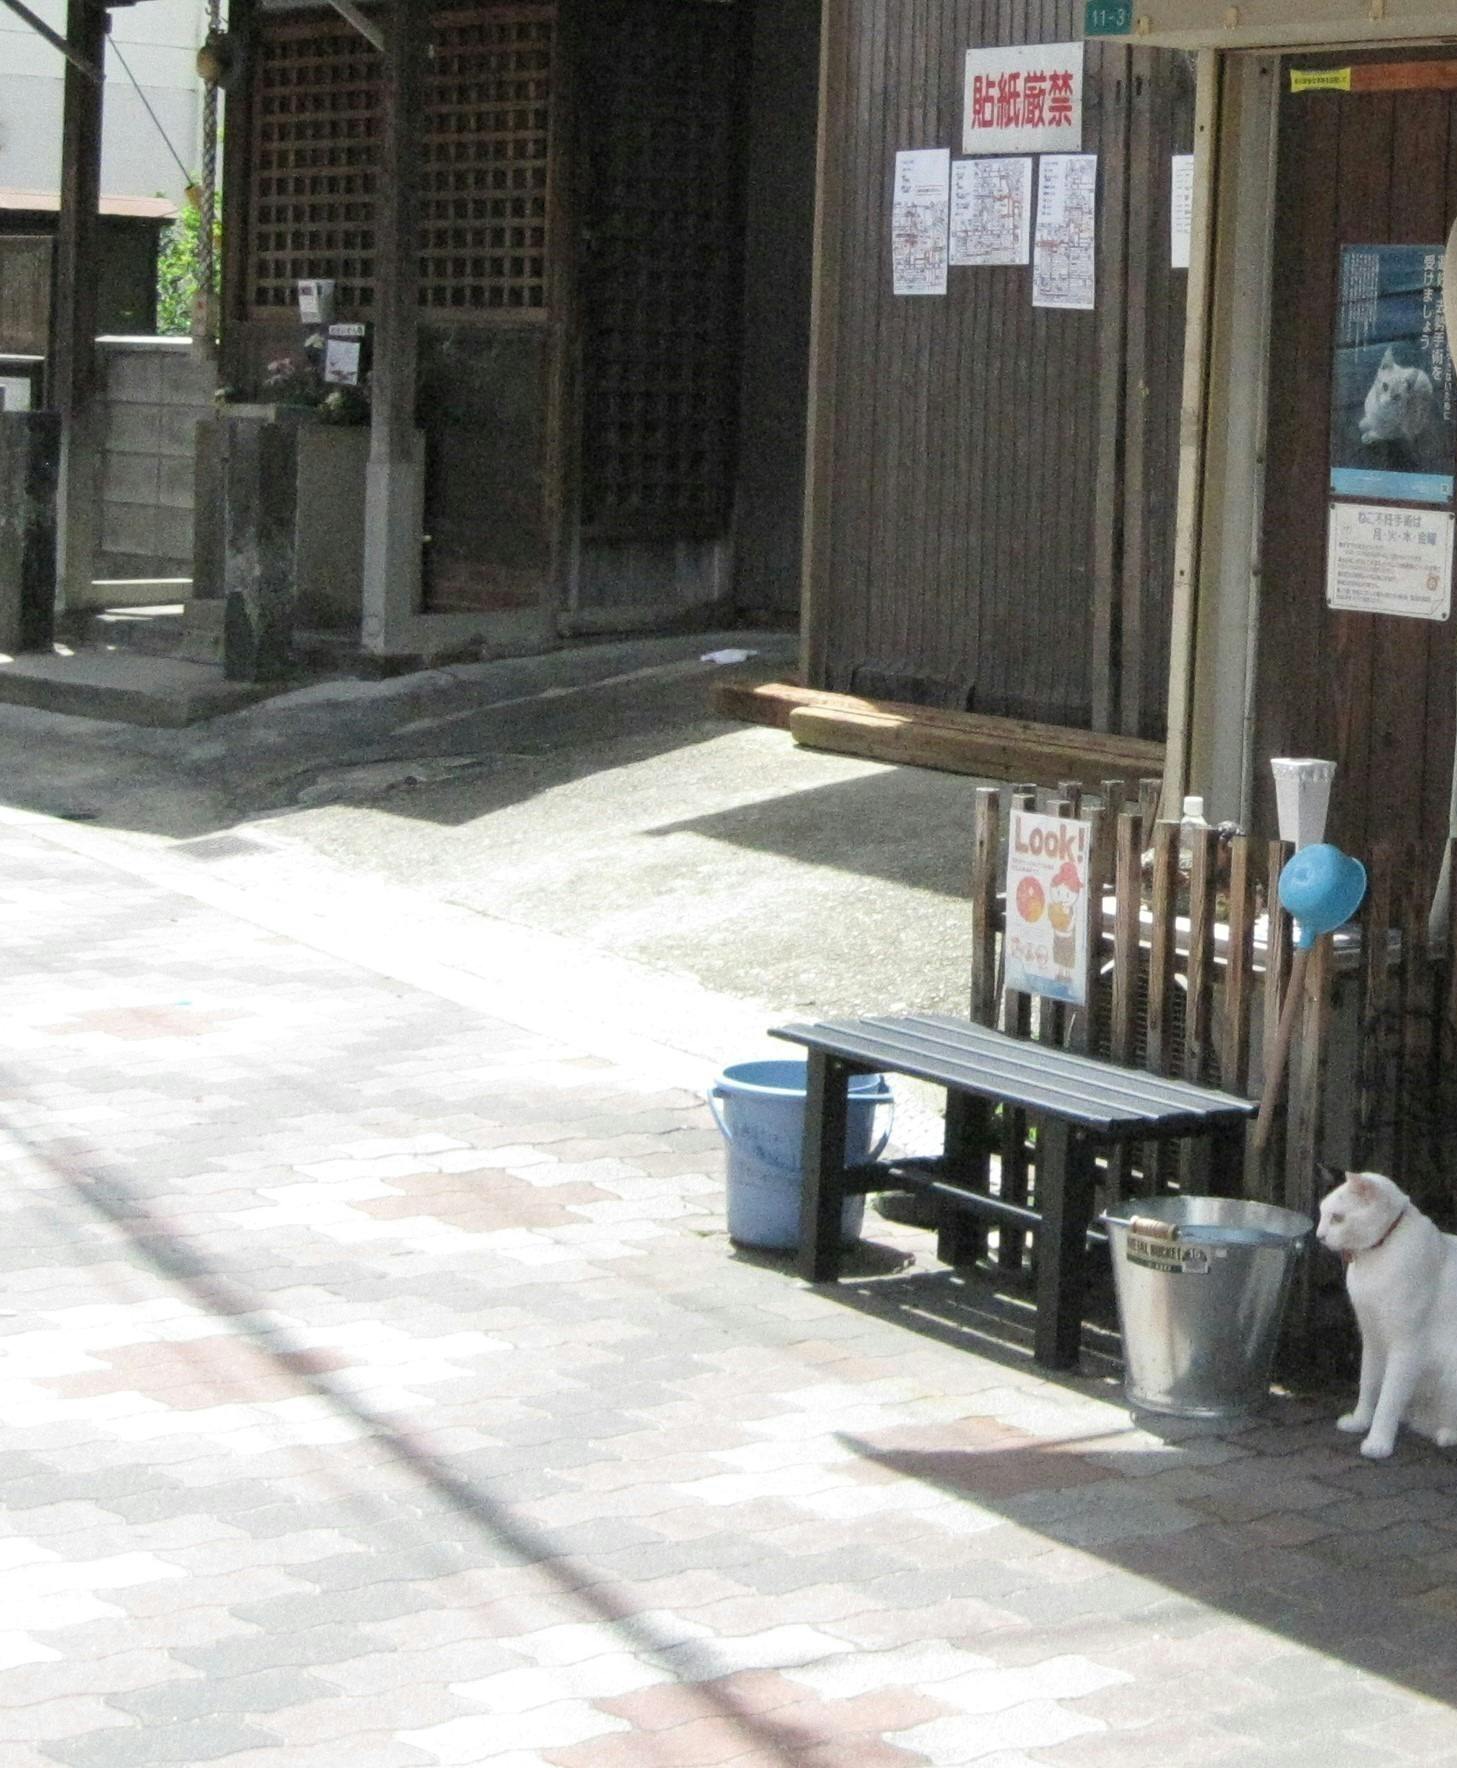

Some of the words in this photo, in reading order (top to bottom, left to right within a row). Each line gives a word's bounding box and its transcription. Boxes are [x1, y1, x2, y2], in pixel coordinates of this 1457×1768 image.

[1091, 8, 1126, 27] 11-3
[971, 69, 1075, 130] 貼紙厳禁
[1015, 815, 1085, 865] Look!
